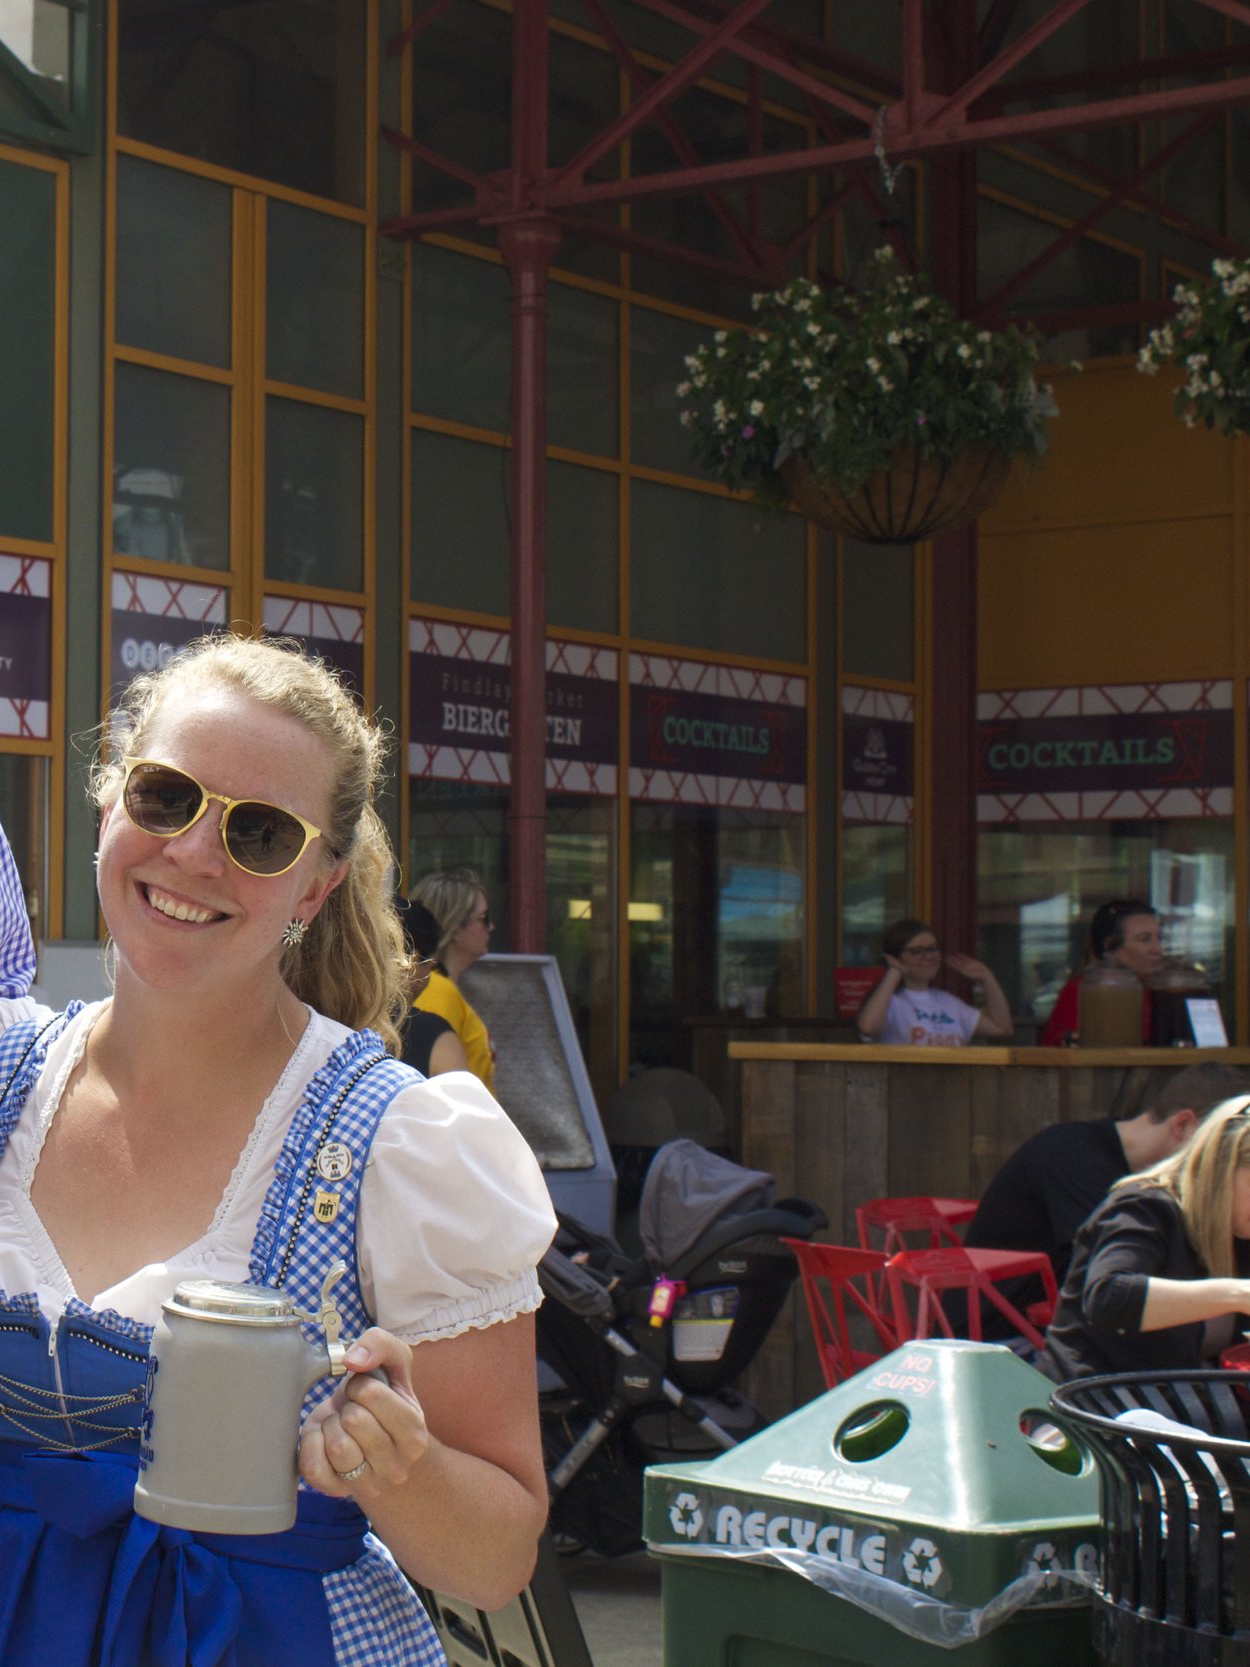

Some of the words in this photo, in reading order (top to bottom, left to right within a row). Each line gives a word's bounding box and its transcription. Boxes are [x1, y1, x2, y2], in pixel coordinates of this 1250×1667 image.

[442, 702, 582, 747] BIERGTEN
[663, 716, 770, 755] COCKTAILS
[988, 737, 1175, 770] COCKTAILS
[876, 1371, 938, 1394] CUPS!
[901, 1355, 933, 1374] NO
[715, 1504, 887, 1576] RECYCLE
